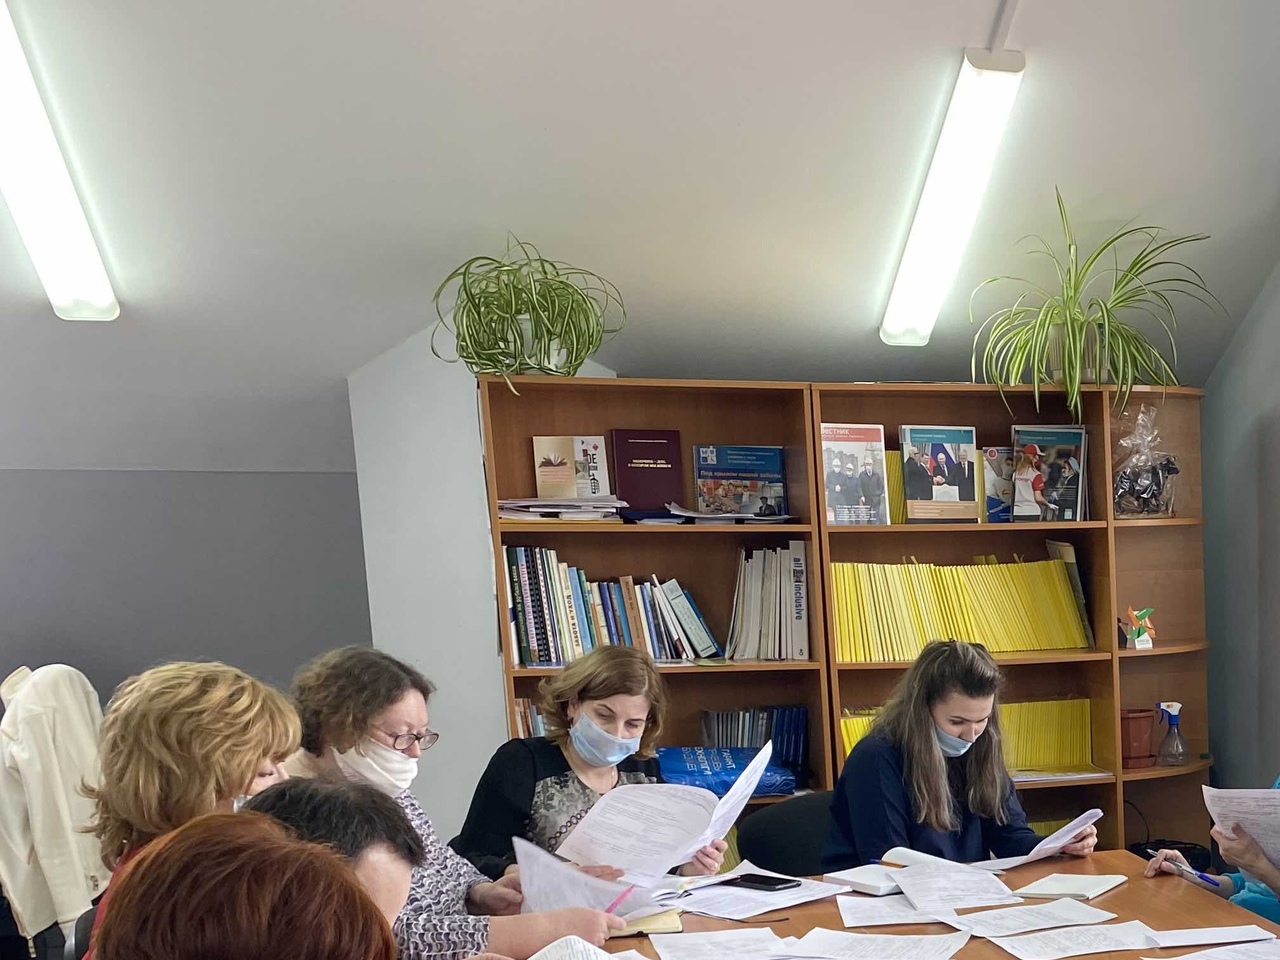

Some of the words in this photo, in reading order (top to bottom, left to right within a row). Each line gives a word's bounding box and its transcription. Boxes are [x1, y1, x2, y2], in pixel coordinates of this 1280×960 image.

[794, 557, 803, 568] all
[566, 594, 574, 614] УХОД
[794, 584, 804, 620] inclusive
[571, 622, 581, 647] ЗАБОТА
